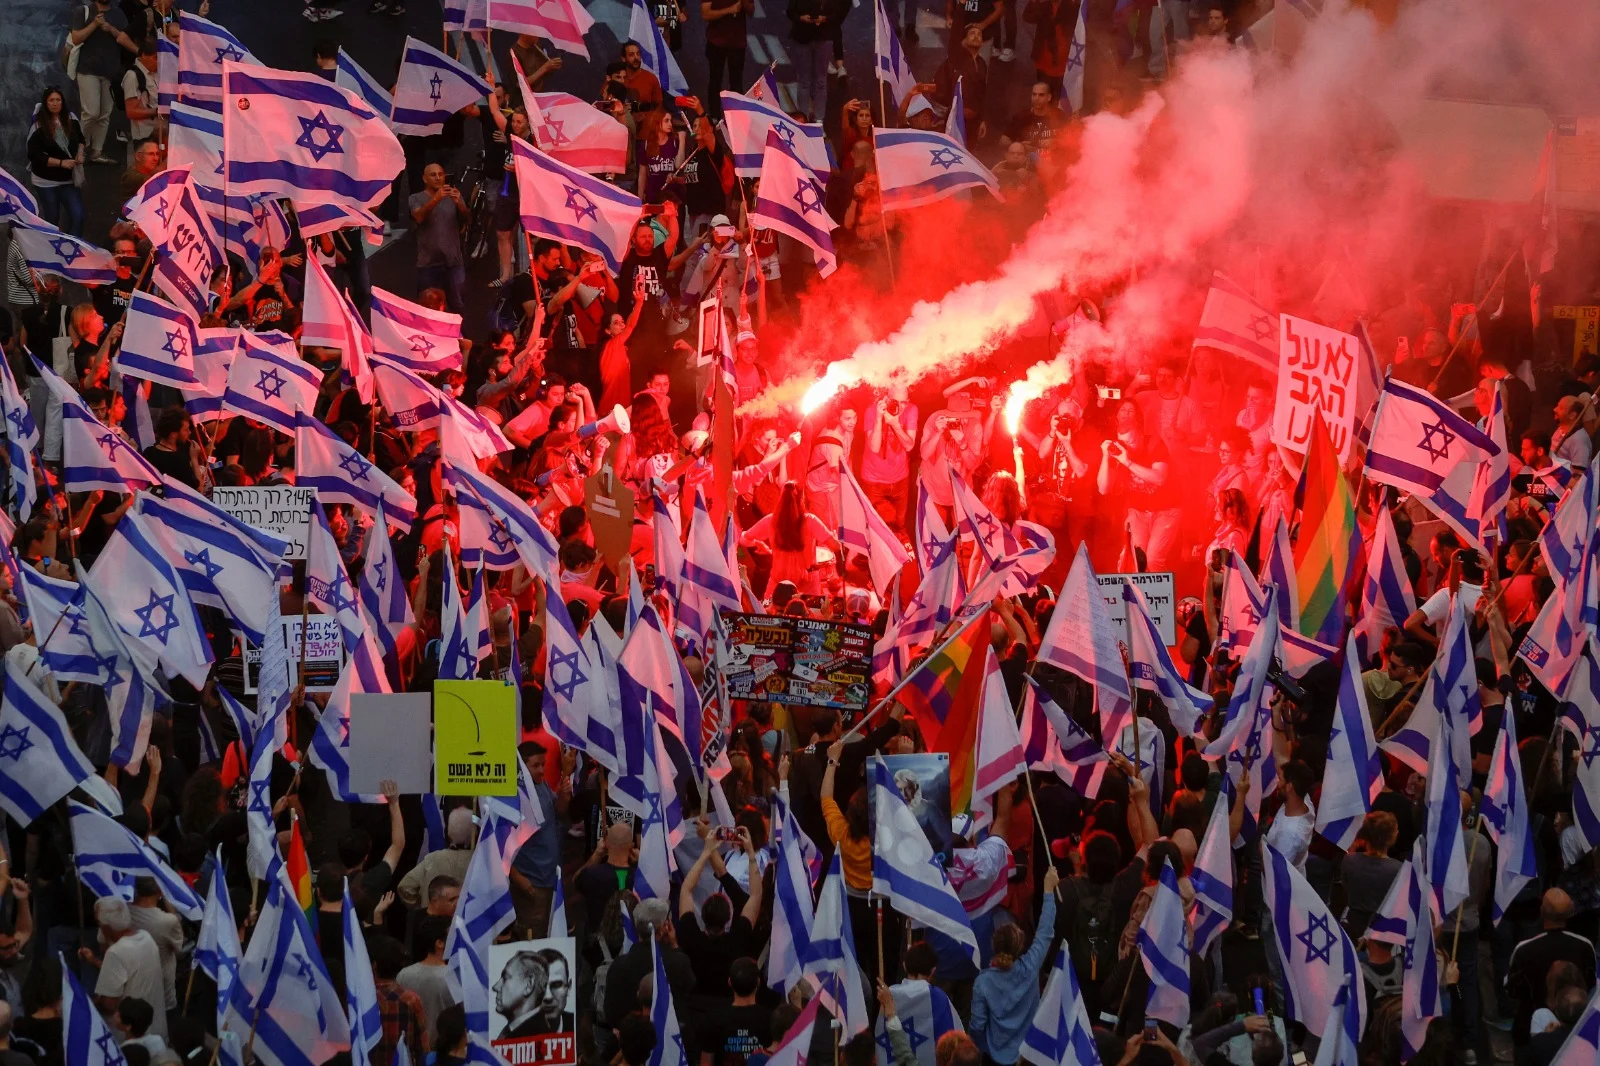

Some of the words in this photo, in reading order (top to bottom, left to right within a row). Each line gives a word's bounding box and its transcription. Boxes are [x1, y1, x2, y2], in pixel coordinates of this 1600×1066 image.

[1582, 307, 1597, 318] 115
[1588, 320, 1595, 330] 8
[1286, 318, 1320, 370] על
[1323, 337, 1354, 387] לא
[1290, 371, 1345, 418] הגב
[1287, 406, 1347, 455] שנו
[213, 488, 260, 506] ההתחלה
[264, 489, 281, 509] רק
[269, 510, 310, 524] בחסות
[292, 621, 321, 631] חמרו
[295, 632, 322, 642] משח
[324, 630, 339, 641] של
[448, 763, 472, 776] גשם
[475, 762, 491, 776] לא
[494, 763, 506, 776] זה
